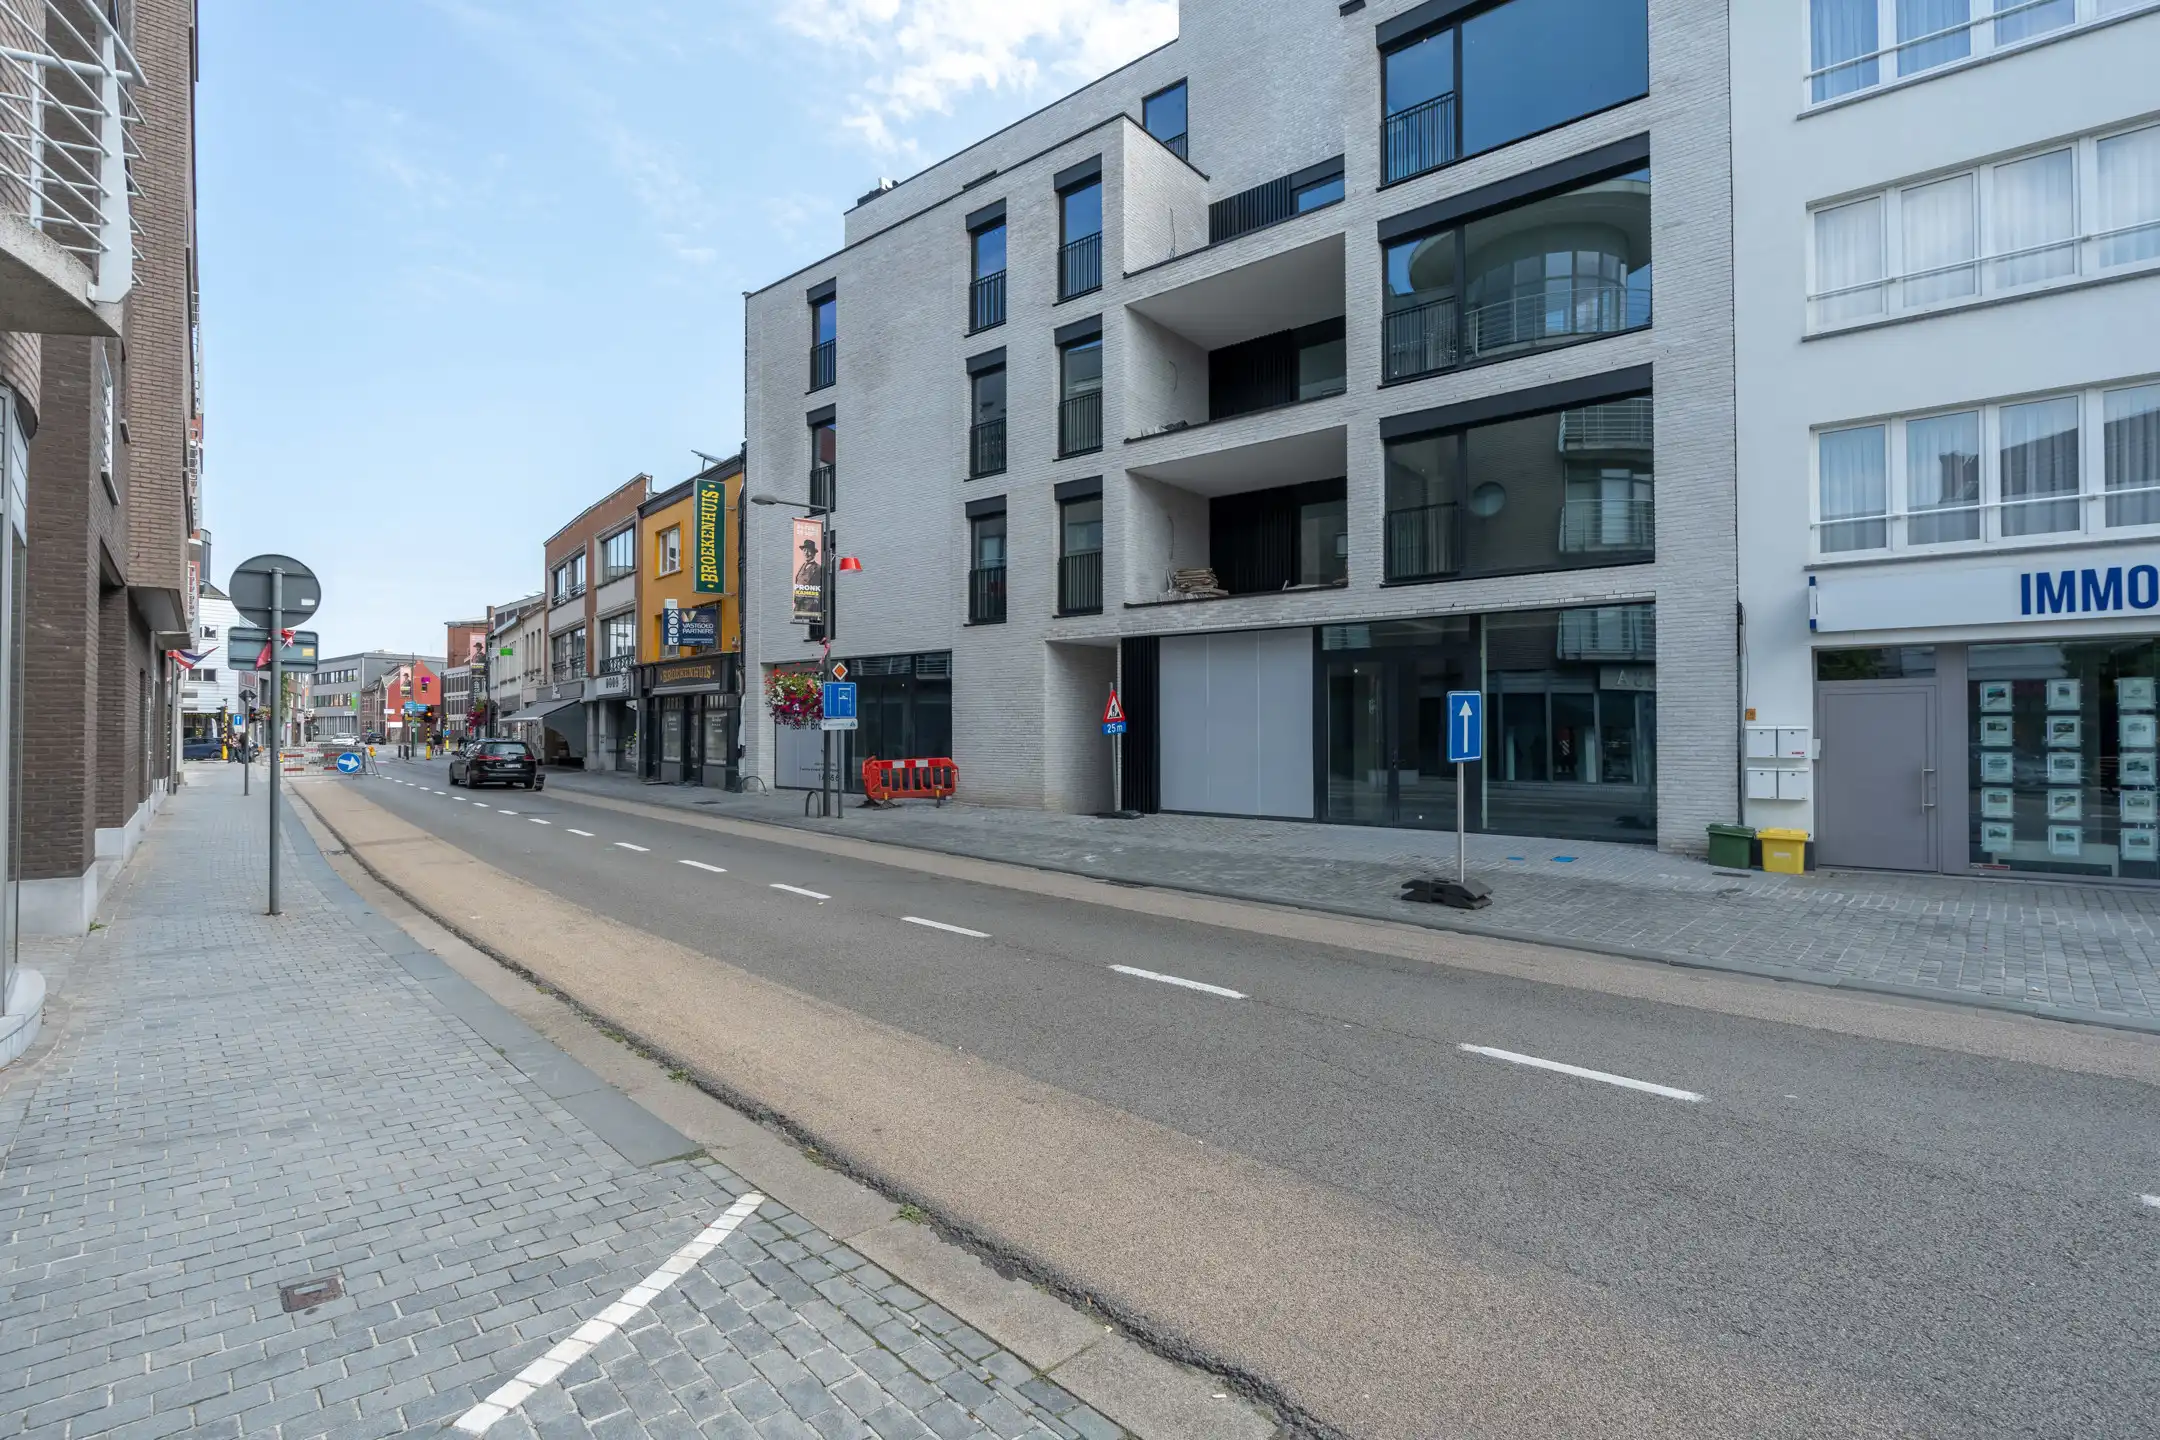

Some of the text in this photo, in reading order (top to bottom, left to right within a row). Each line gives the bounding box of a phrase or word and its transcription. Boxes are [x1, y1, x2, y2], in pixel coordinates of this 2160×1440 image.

[701, 490, 719, 583] BROEKENHUIS
[794, 584, 821, 592] PRONK
[2021, 564, 2158, 615] IMMO
[667, 608, 679, 645] KOOP
